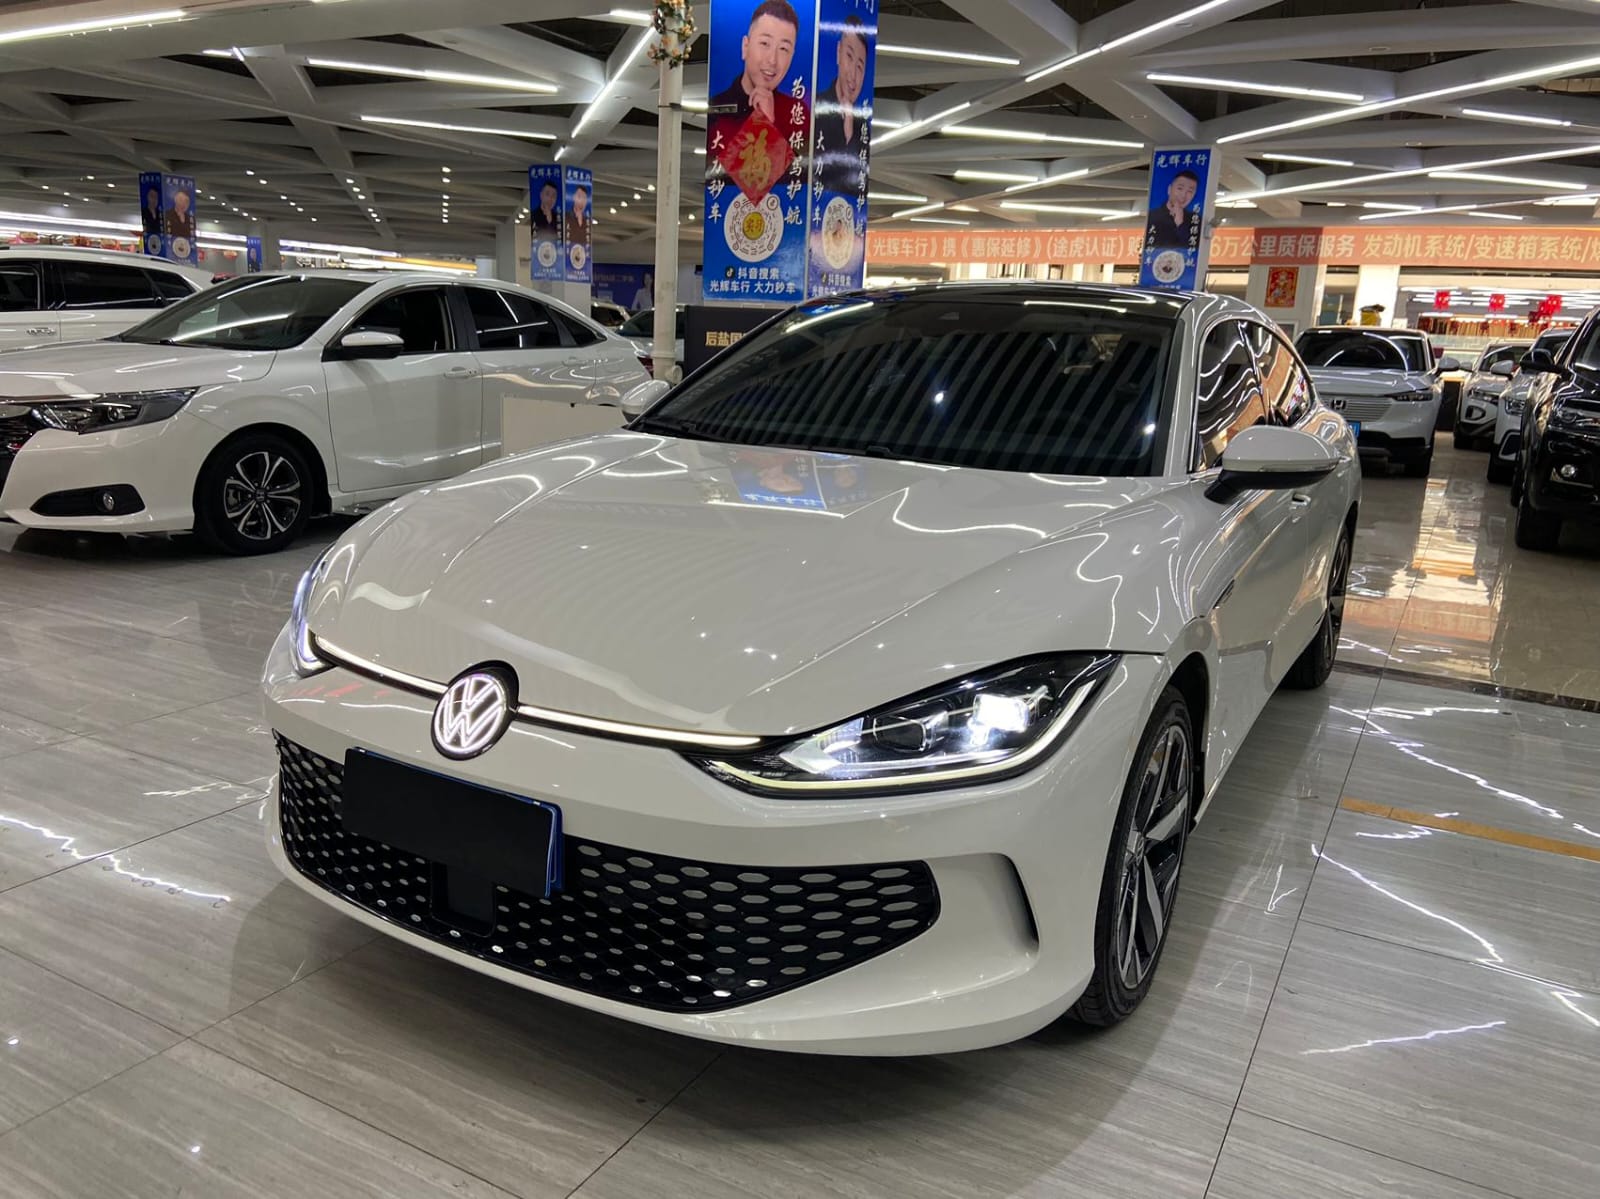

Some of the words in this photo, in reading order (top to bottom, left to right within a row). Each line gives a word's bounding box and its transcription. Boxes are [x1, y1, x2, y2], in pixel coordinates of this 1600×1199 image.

[784, 76, 806, 225] 为您保驾护航
[737, 128, 772, 191] 福
[738, 267, 780, 280] 抖音搜索
[710, 279, 750, 293] 光辉车行
[754, 281, 797, 295] 大力秒车
[705, 331, 746, 347] 后盐国
